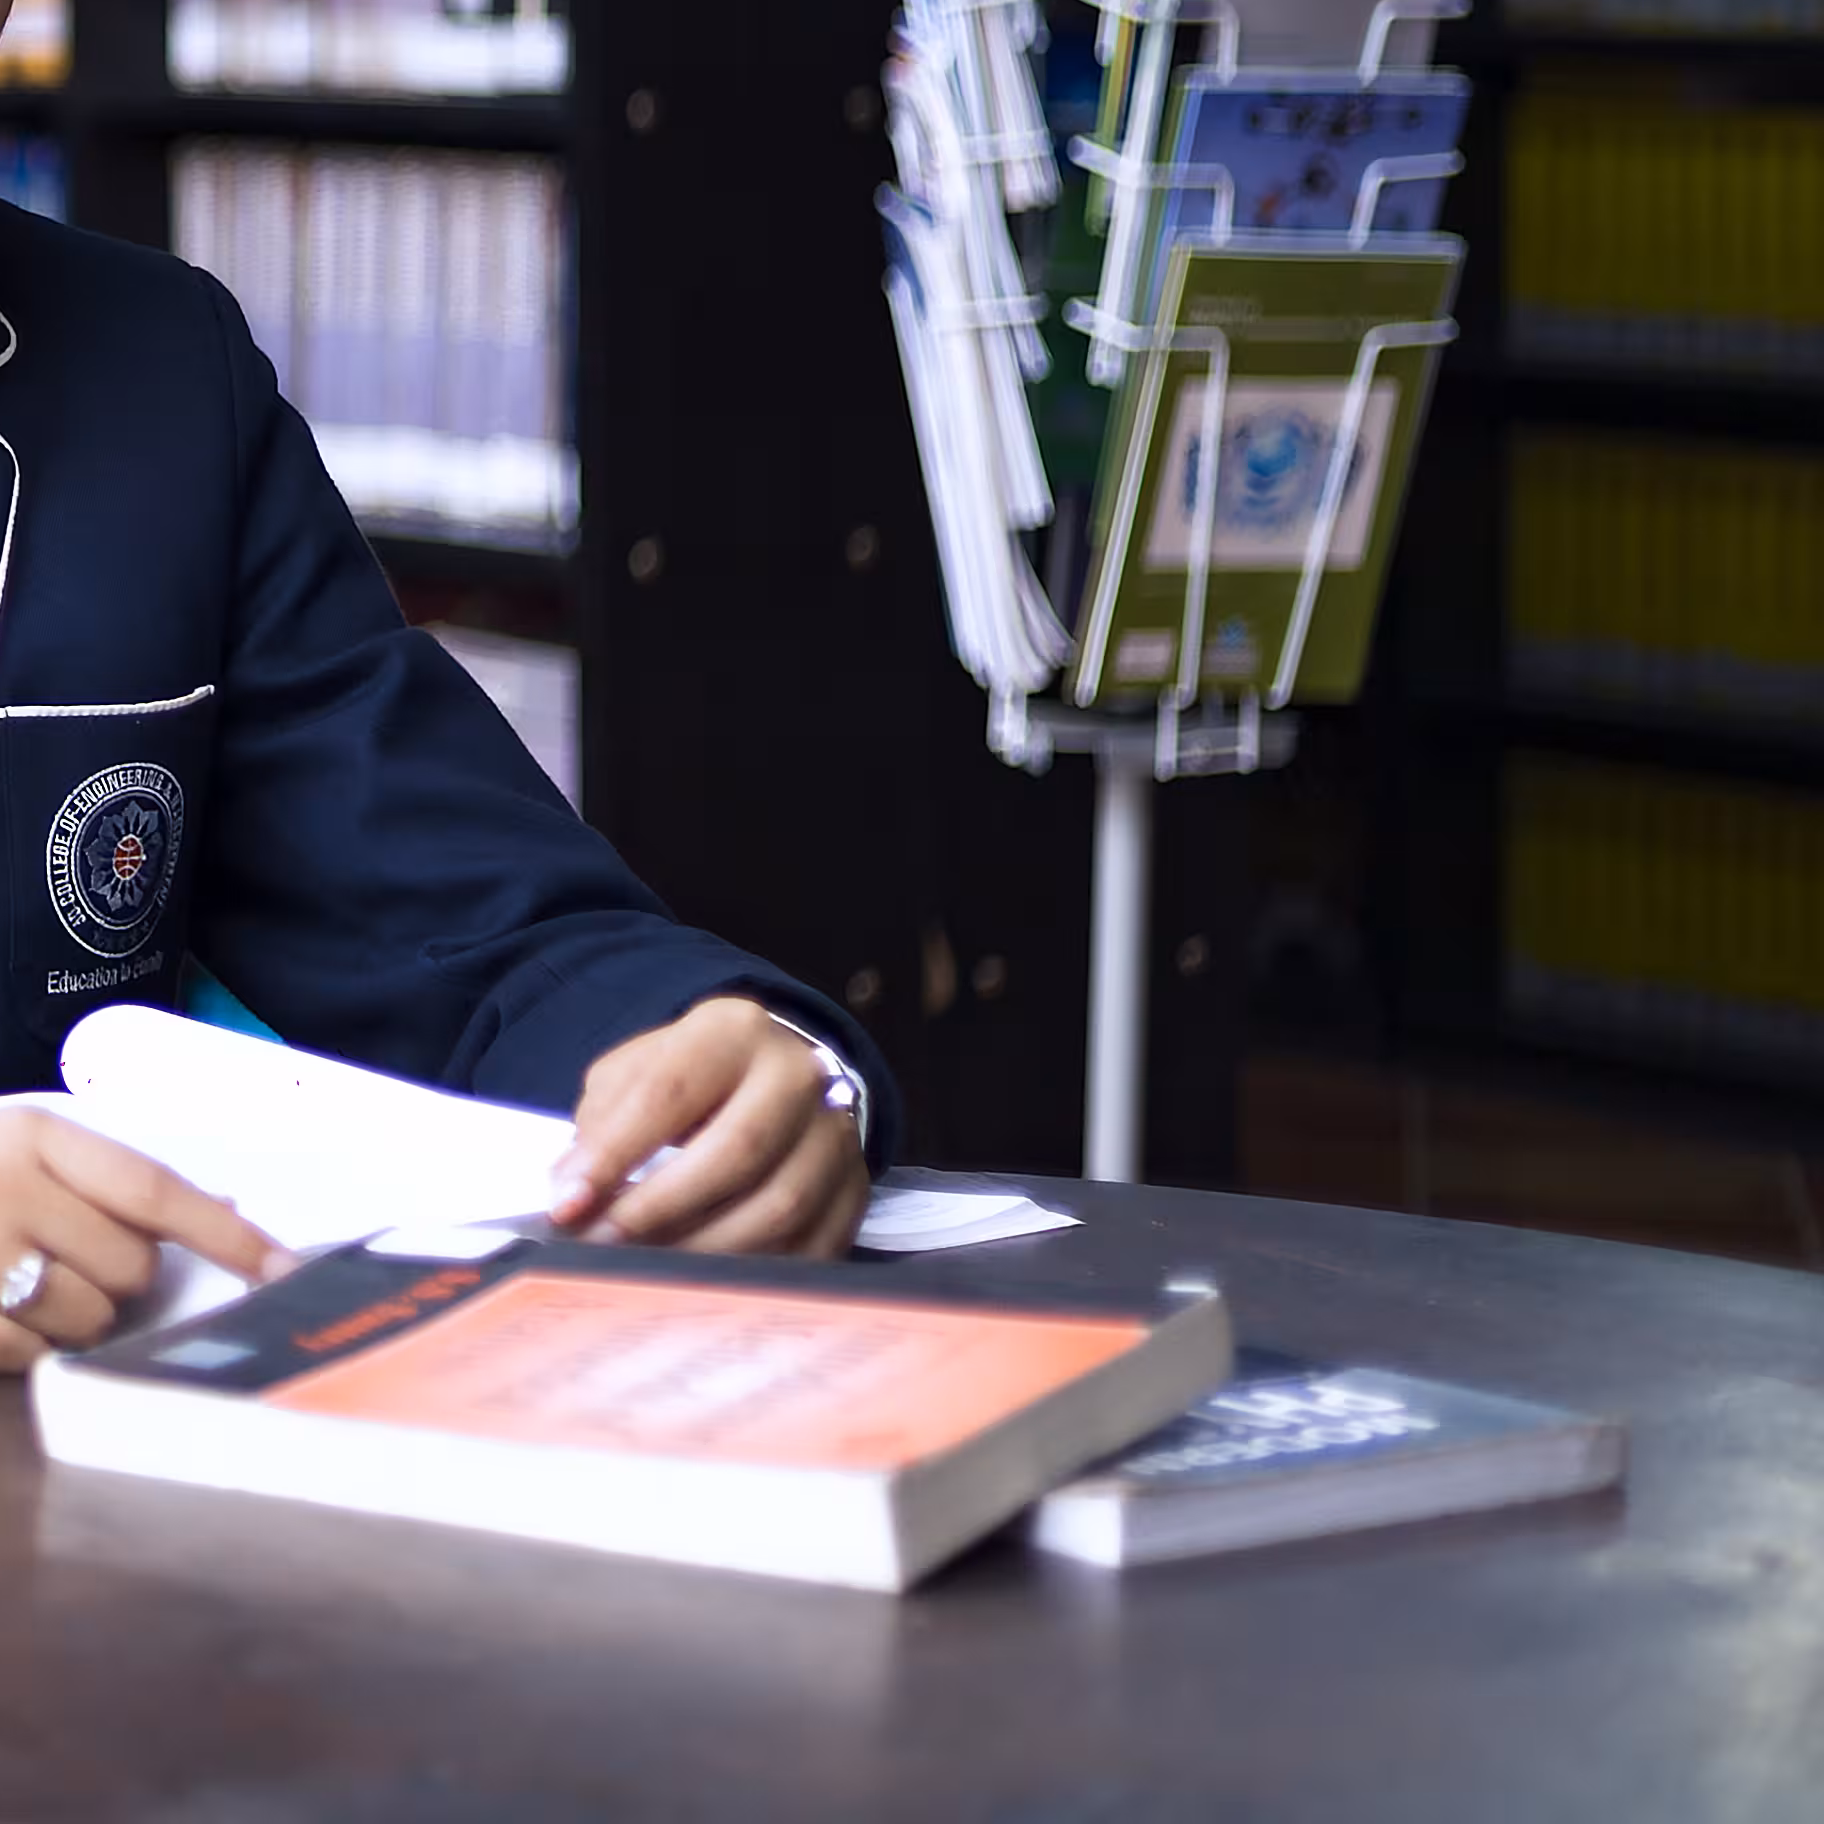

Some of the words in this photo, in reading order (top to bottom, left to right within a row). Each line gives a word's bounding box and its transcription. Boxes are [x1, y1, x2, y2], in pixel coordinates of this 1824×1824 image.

[53, 833, 76, 906] COLLEGE
[73, 769, 163, 814] ENGINEERING
[47, 965, 118, 995] Education
